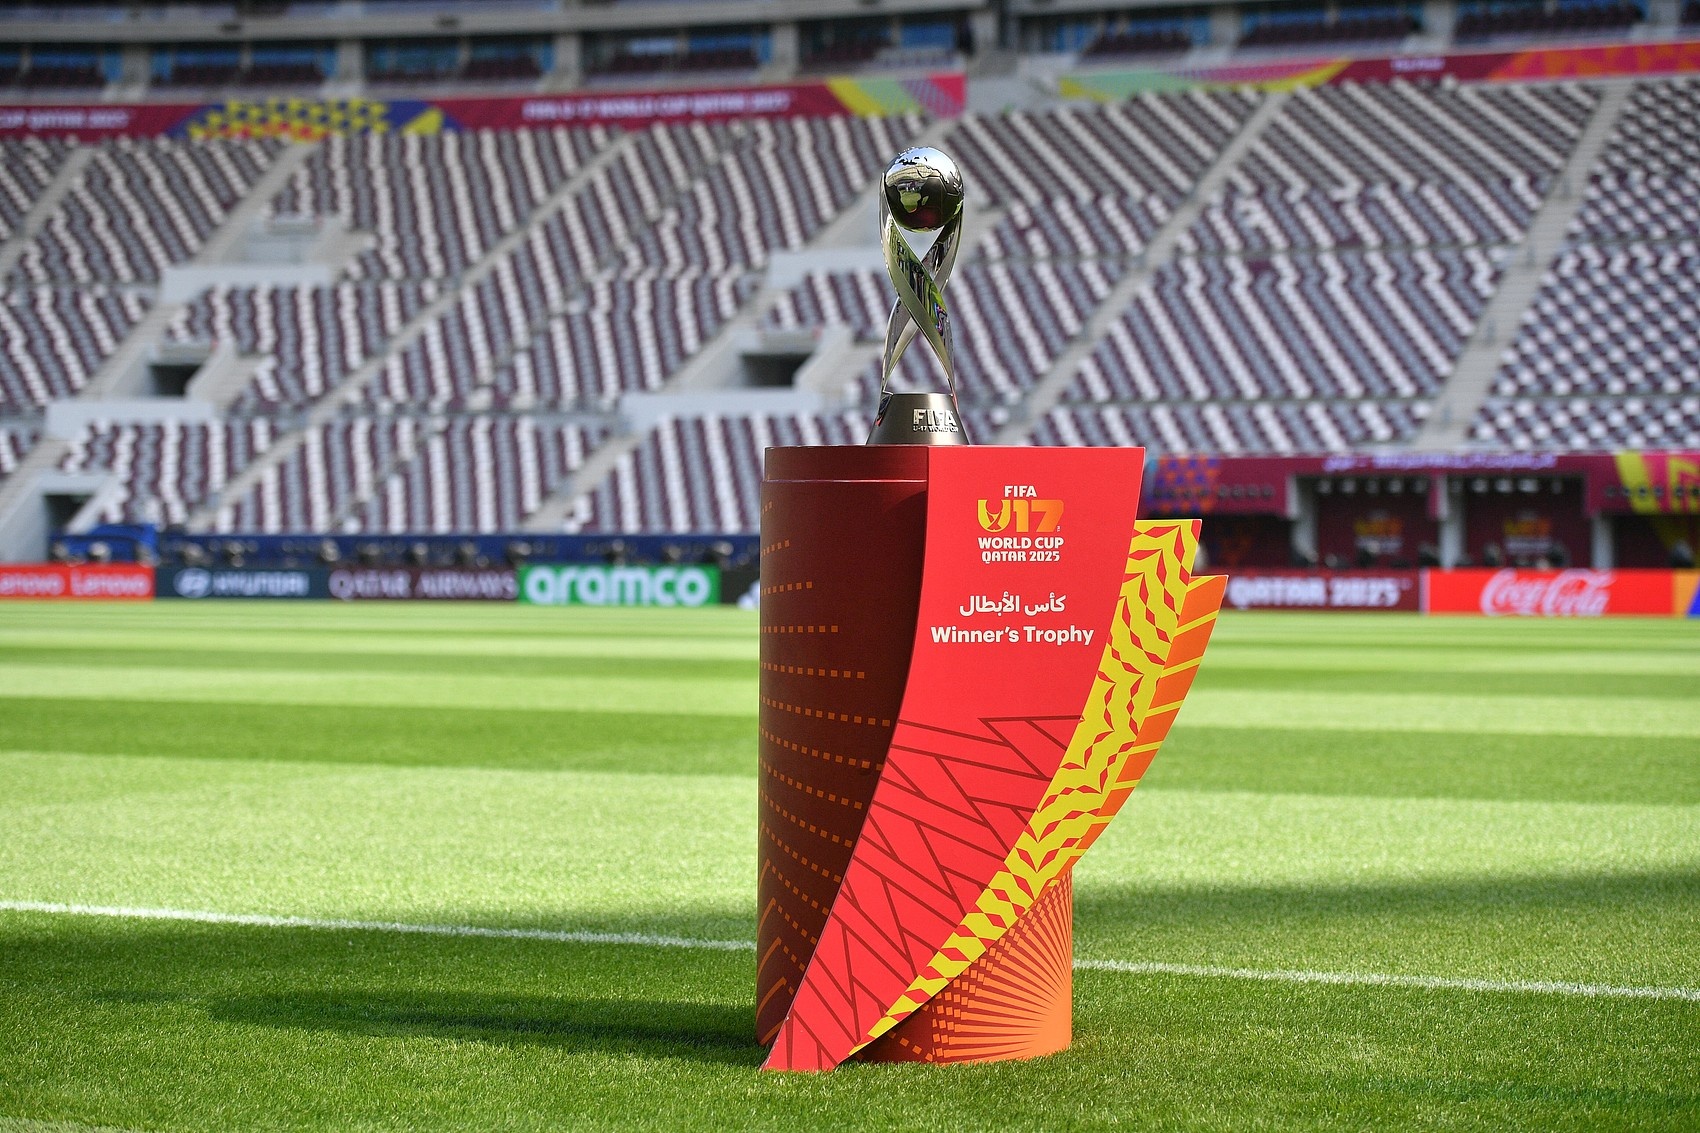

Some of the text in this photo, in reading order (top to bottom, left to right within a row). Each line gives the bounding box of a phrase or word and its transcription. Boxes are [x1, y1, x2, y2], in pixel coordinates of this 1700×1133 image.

[913, 408, 957, 426] FIFA
[1004, 485, 1037, 498] FIFA
[977, 499, 1064, 532] U17
[977, 537, 1064, 549] WORLD CUP
[981, 551, 1060, 564] QATAR 2025
[0, 568, 150, 596] enovo Lenovo
[212, 571, 310, 596] HYUNDAI
[329, 570, 519, 599] QATAR AIRWAYS
[524, 567, 712, 606] aramco
[1228, 577, 1400, 608] QATAR 2025
[1479, 568, 1614, 615] Coca-Cola
[959, 591, 1066, 616] كأس الأبطال
[931, 625, 1094, 645] Winner's Trophy
